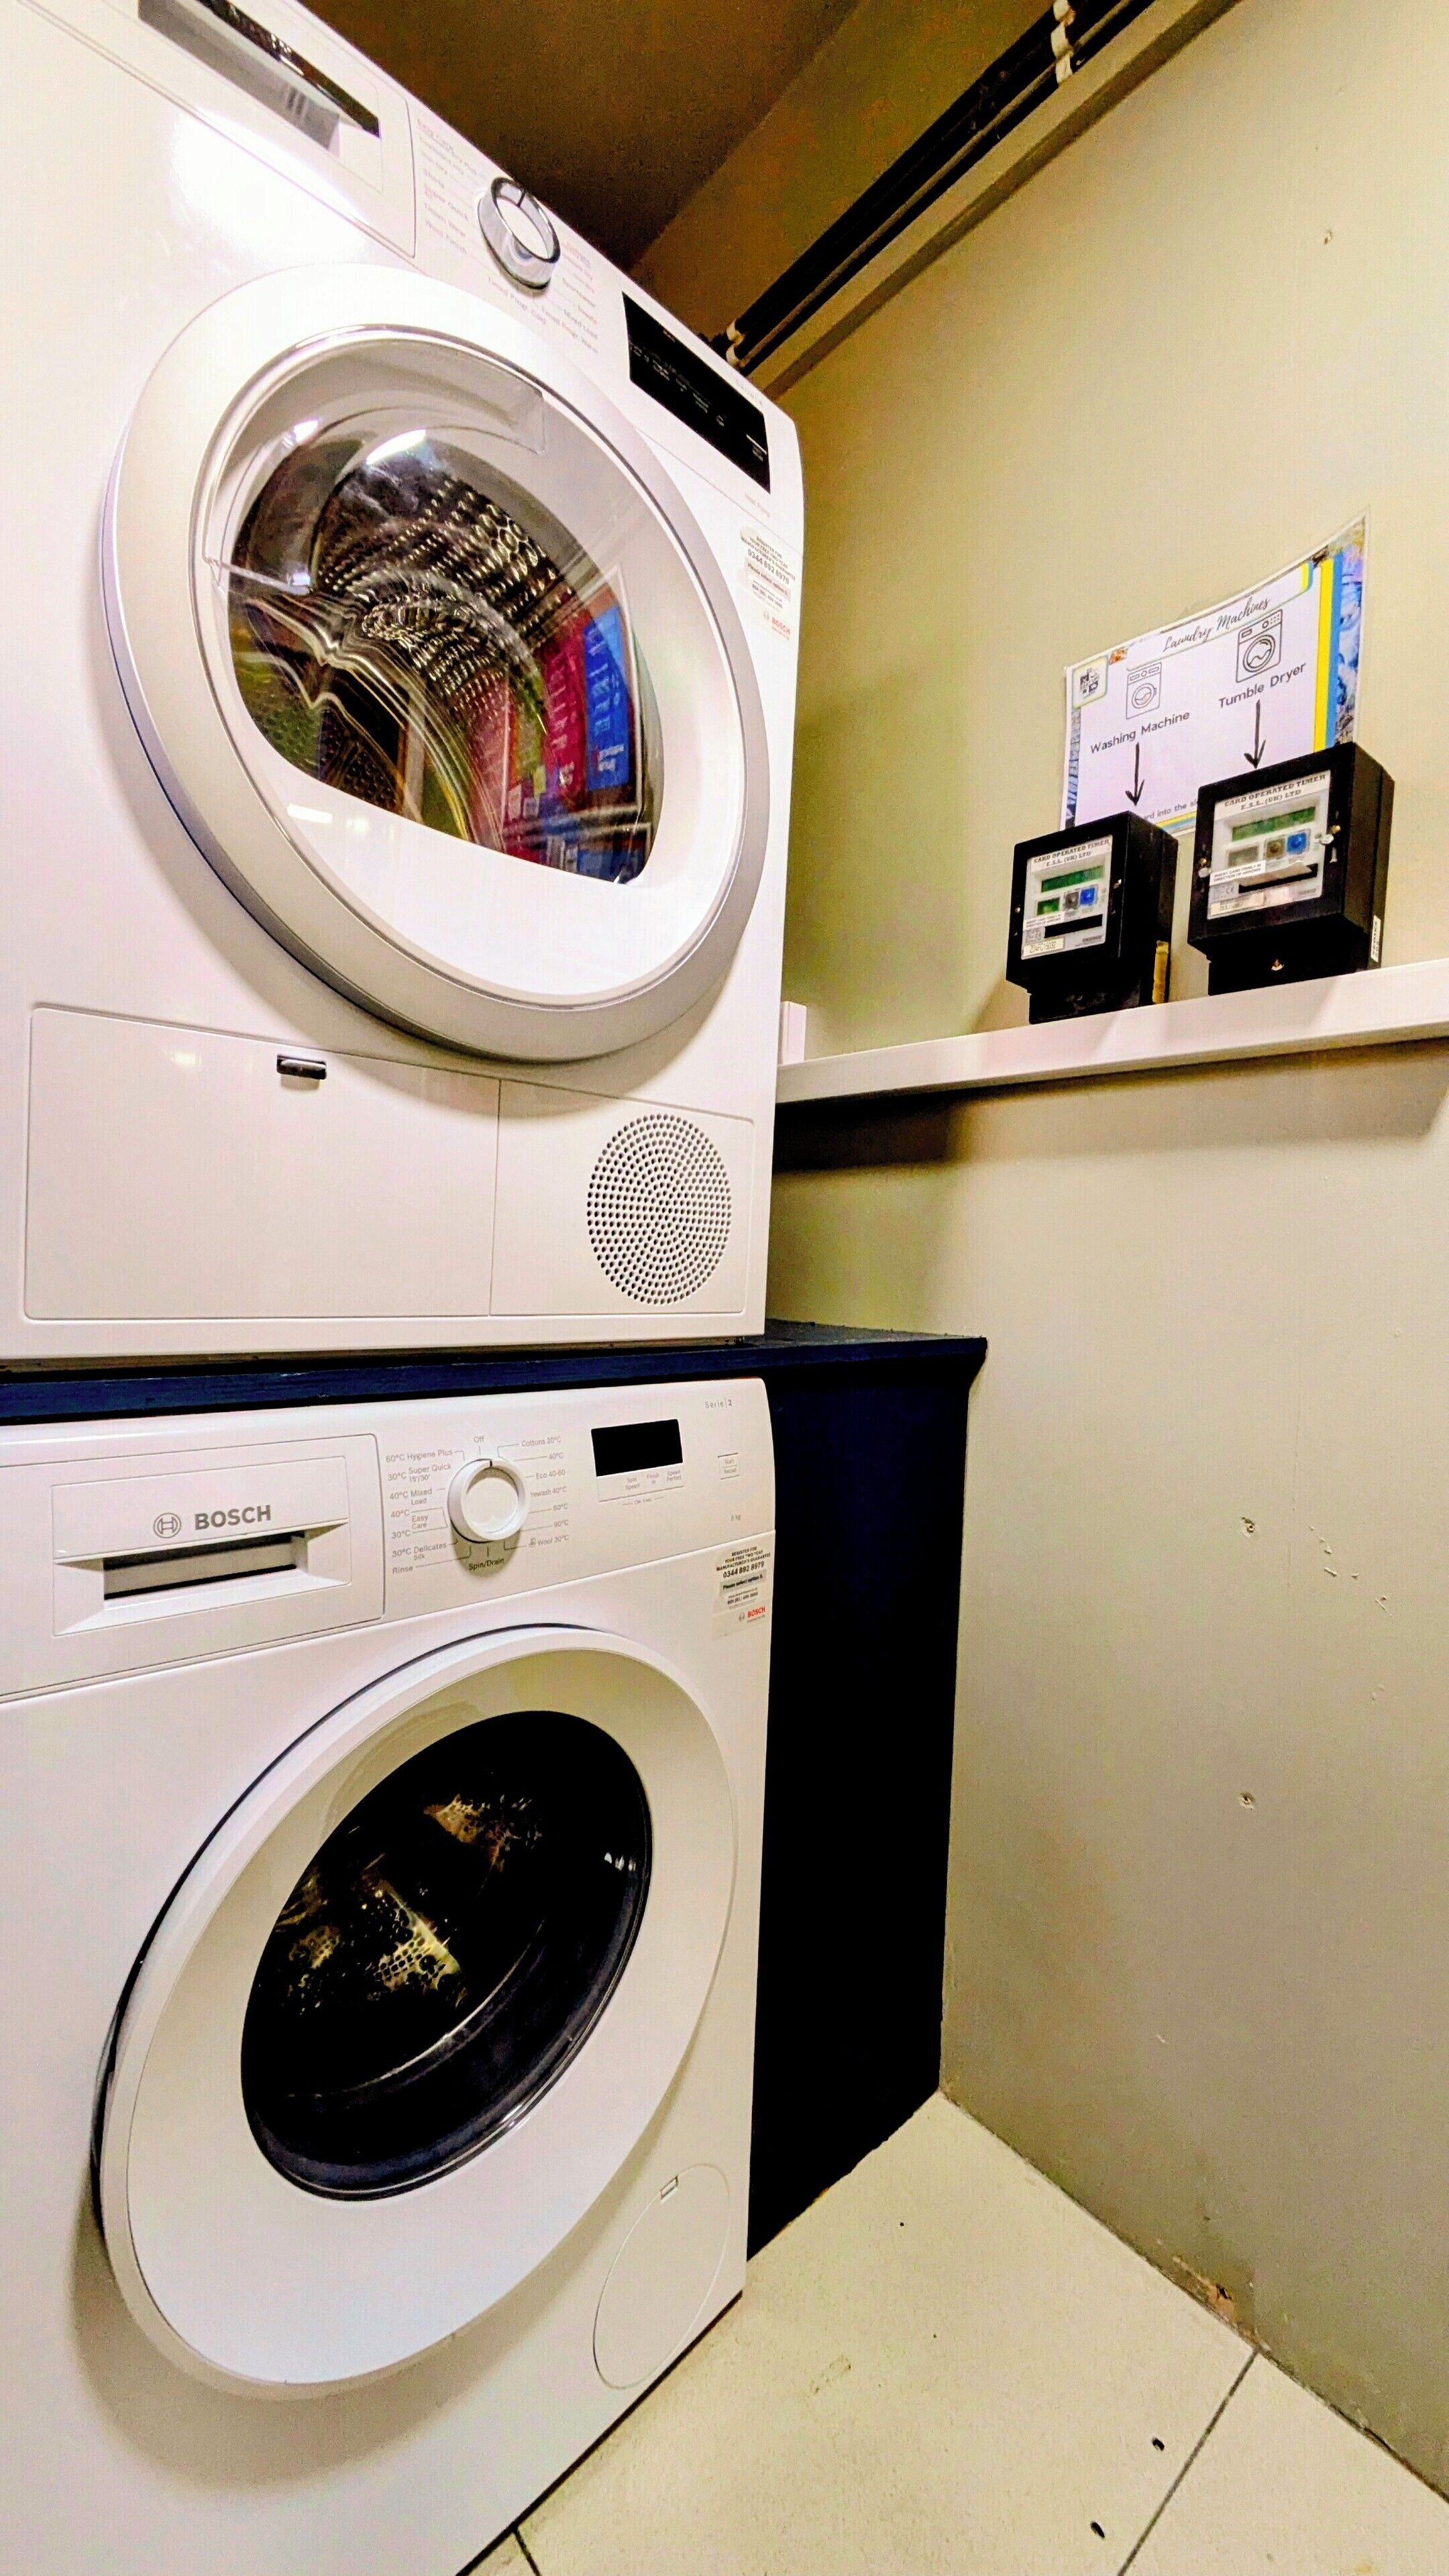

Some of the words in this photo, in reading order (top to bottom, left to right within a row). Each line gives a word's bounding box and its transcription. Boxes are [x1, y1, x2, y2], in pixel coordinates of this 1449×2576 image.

[747, 548, 762, 564] 0344
[771, 616, 790, 635] BOSCH
[1163, 625, 1212, 653] Laundry
[1216, 596, 1271, 632] Machines
[1218, 683, 1265, 710] Tumble
[1269, 663, 1307, 689] Dryer
[1090, 728, 1136, 754] Washing
[1140, 710, 1190, 737] Machine
[1224, 796, 1246, 808] CARD
[1248, 784, 1294, 802] OPERATED
[1295, 774, 1326, 788] TIMER
[1285, 789, 1301, 799] LTD
[1157, 808, 1171, 817] into
[1174, 804, 1187, 812] the
[1034, 855, 1051, 864] CARD
[1053, 845, 1086, 859] OPERATED
[1087, 838, 1110, 851] TIMER
[1078, 851, 1091, 860] LTD
[474, 1435, 484, 1444] Off
[521, 1439, 545, 1448] Cottons
[546, 1436, 562, 1444] 20°C
[386, 1454, 405, 1463] 60°C
[407, 1451, 436, 1462] Hygiene
[437, 1448, 453, 1457] Plus
[549, 1452, 564, 1460] 40°C
[409, 1465, 430, 1477] Super
[431, 1462, 451, 1472] Quick
[536, 1472, 546, 1480] Eco
[547, 1469, 566, 1478] 40-60
[388, 1472, 407, 1482] 30°C
[389, 1491, 408, 1501] 40°C
[410, 1487, 432, 1498] Mixed
[531, 1488, 552, 1498] rewash
[553, 1485, 568, 1494] 40°C
[411, 1497, 427, 1506] Load
[195, 1505, 272, 1531] BOSCH
[391, 1509, 409, 1519] 40°C
[412, 1515, 428, 1525] Easy
[412, 1521, 427, 1530] Care
[391, 1529, 411, 1540] 30°C
[537, 1538, 553, 1546] Wool
[554, 1534, 569, 1543] 30°C
[392, 1547, 411, 1558] 30°C
[413, 1542, 447, 1554] Delicates
[731, 1548, 749, 1557] REGISTER
[413, 1554, 425, 1562] Silk
[468, 1557, 504, 1571] Spin/Drain
[750, 1552, 771, 1564] GUARANTEE
[392, 1564, 413, 1574] Rinse
[723, 1568, 738, 1578] 0344
[739, 1564, 750, 1574] 892
[751, 1560, 765, 1571] 8979
[736, 1578, 747, 1587] select
[747, 1575, 759, 1583] option
[747, 1605, 766, 1618] BOSCH
